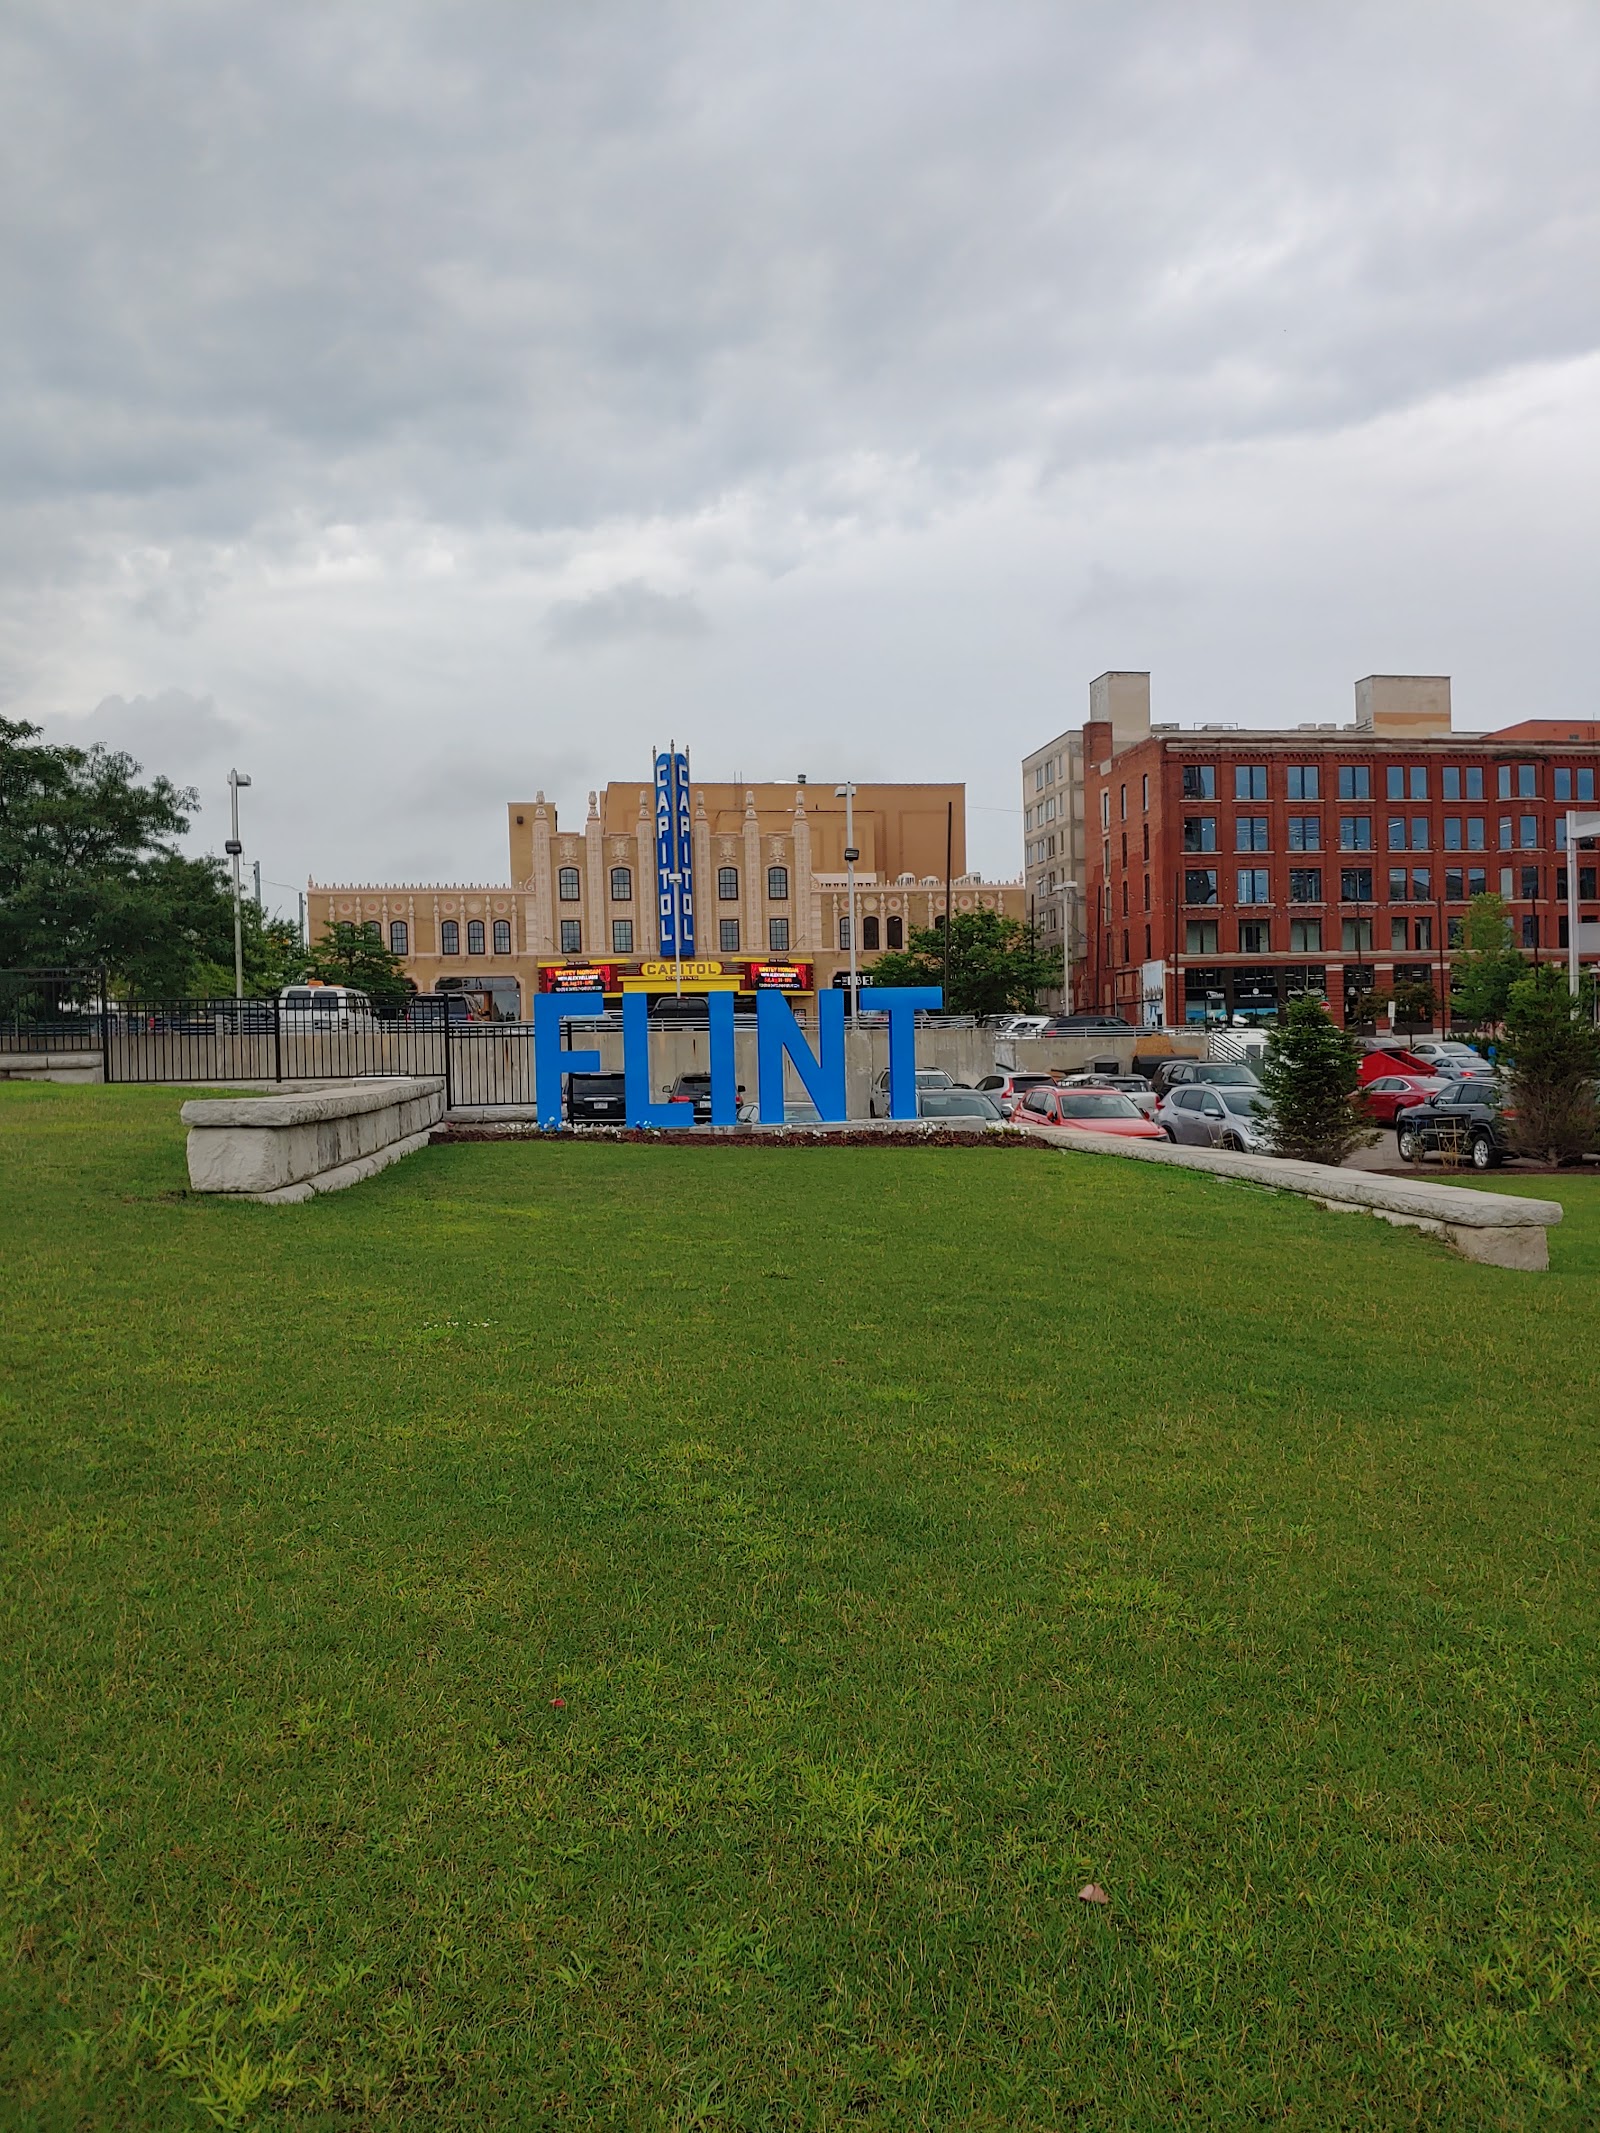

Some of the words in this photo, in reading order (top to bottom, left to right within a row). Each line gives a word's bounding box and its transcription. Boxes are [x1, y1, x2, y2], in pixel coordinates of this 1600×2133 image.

[656, 764, 672, 941] CAPITOL
[678, 764, 693, 941] CAPITOL
[646, 963, 717, 975] CAPITOL
[534, 986, 943, 1130] FLINT
